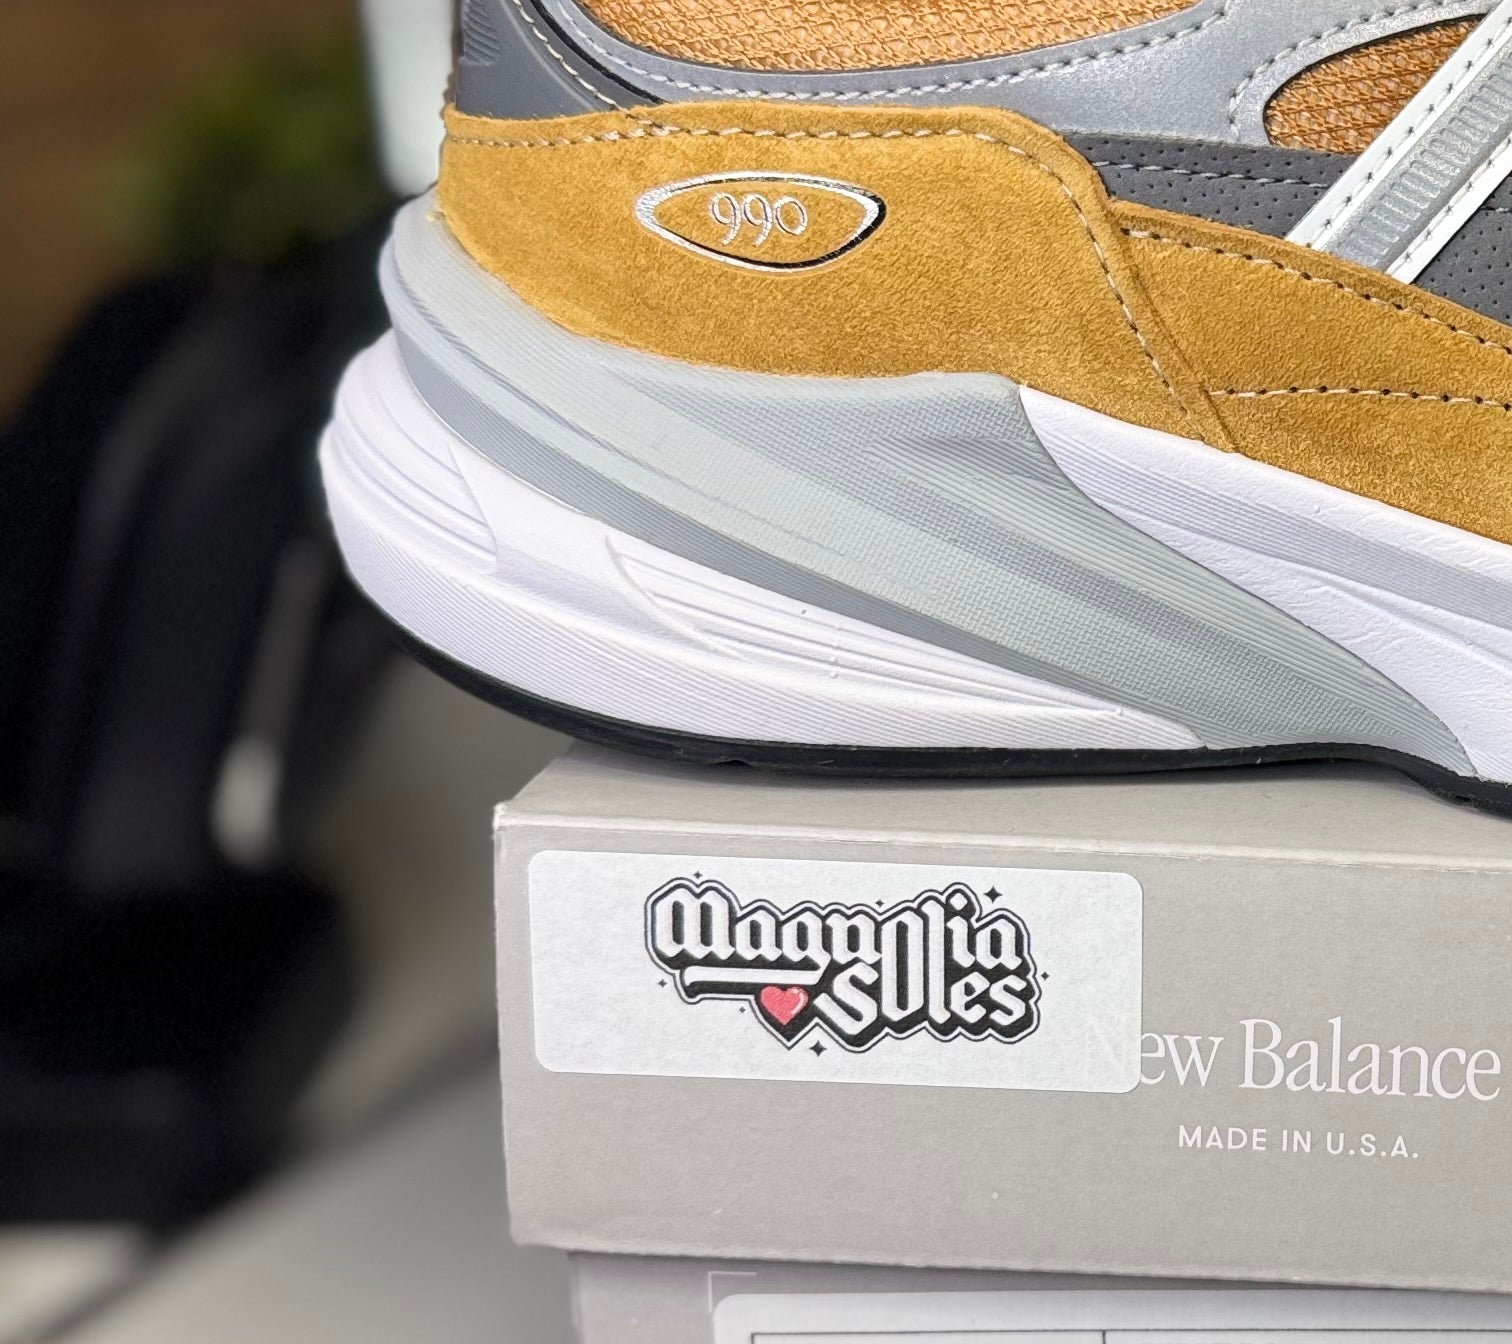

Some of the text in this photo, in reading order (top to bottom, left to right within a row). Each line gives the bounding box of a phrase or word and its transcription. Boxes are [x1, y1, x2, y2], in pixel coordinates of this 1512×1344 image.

[711, 192, 808, 247] 990
[652, 882, 1024, 1006] Magnolia
[1139, 1015, 1501, 1101] ew Balance
[1177, 1124, 1420, 1159] MADE IN U.S.A.
